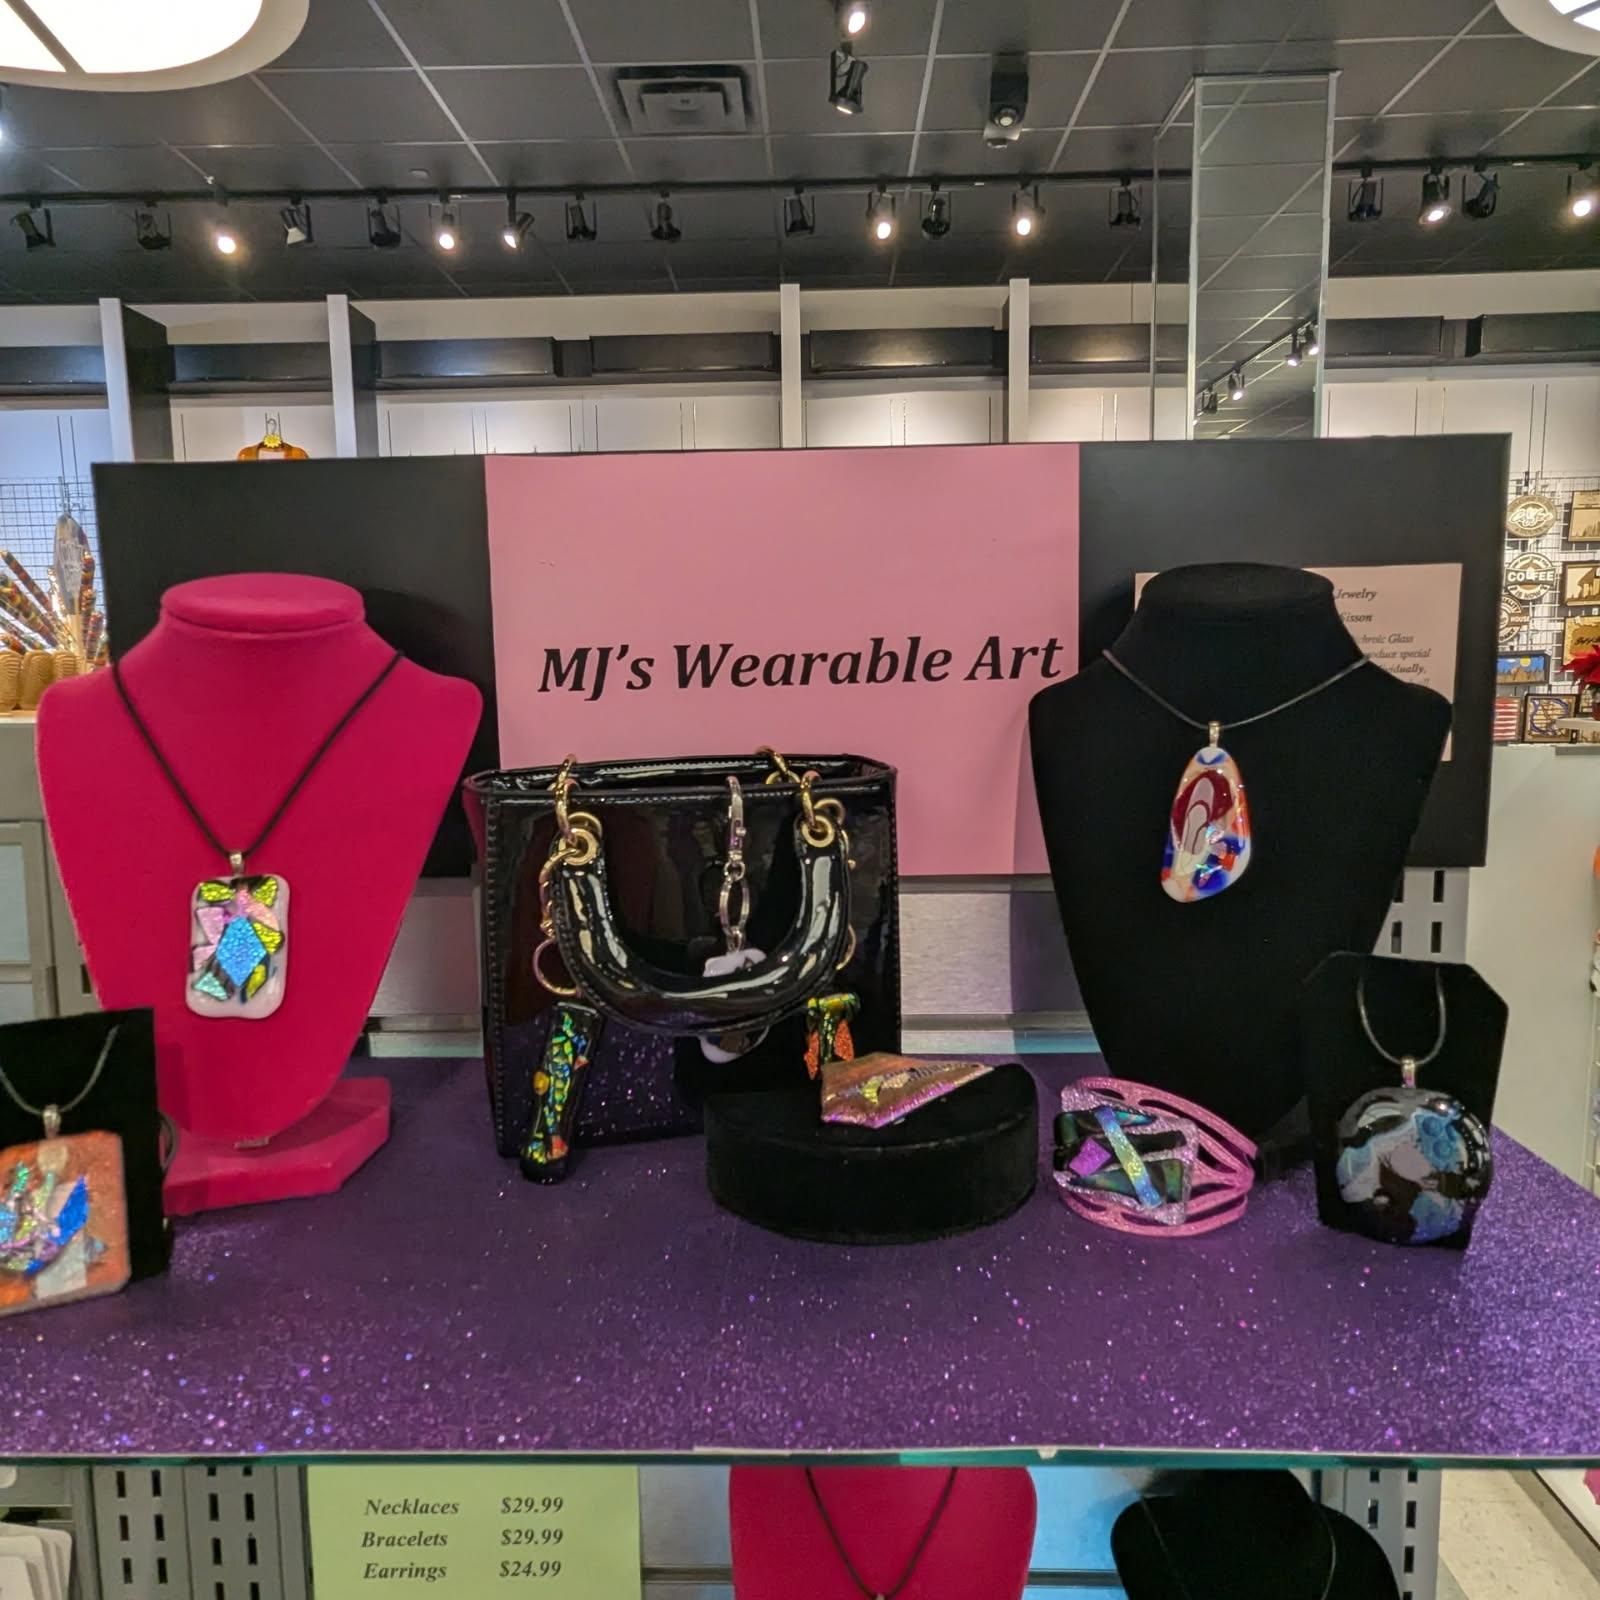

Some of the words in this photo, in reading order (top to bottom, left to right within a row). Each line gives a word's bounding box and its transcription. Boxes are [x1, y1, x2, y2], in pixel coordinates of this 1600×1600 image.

[1335, 588, 1378, 602] Jewelry
[1388, 633, 1414, 644] Glass
[673, 636, 952, 690] Wearable
[964, 636, 1063, 681] Art
[1399, 648, 1431, 660] special
[364, 1498, 460, 1516] Necklaces
[501, 1496, 564, 1514] $29.99
[361, 1530, 449, 1548] Bracelets
[501, 1528, 564, 1545] $29.99
[363, 1562, 448, 1582] Earrings
[499, 1560, 562, 1578] $24.99
